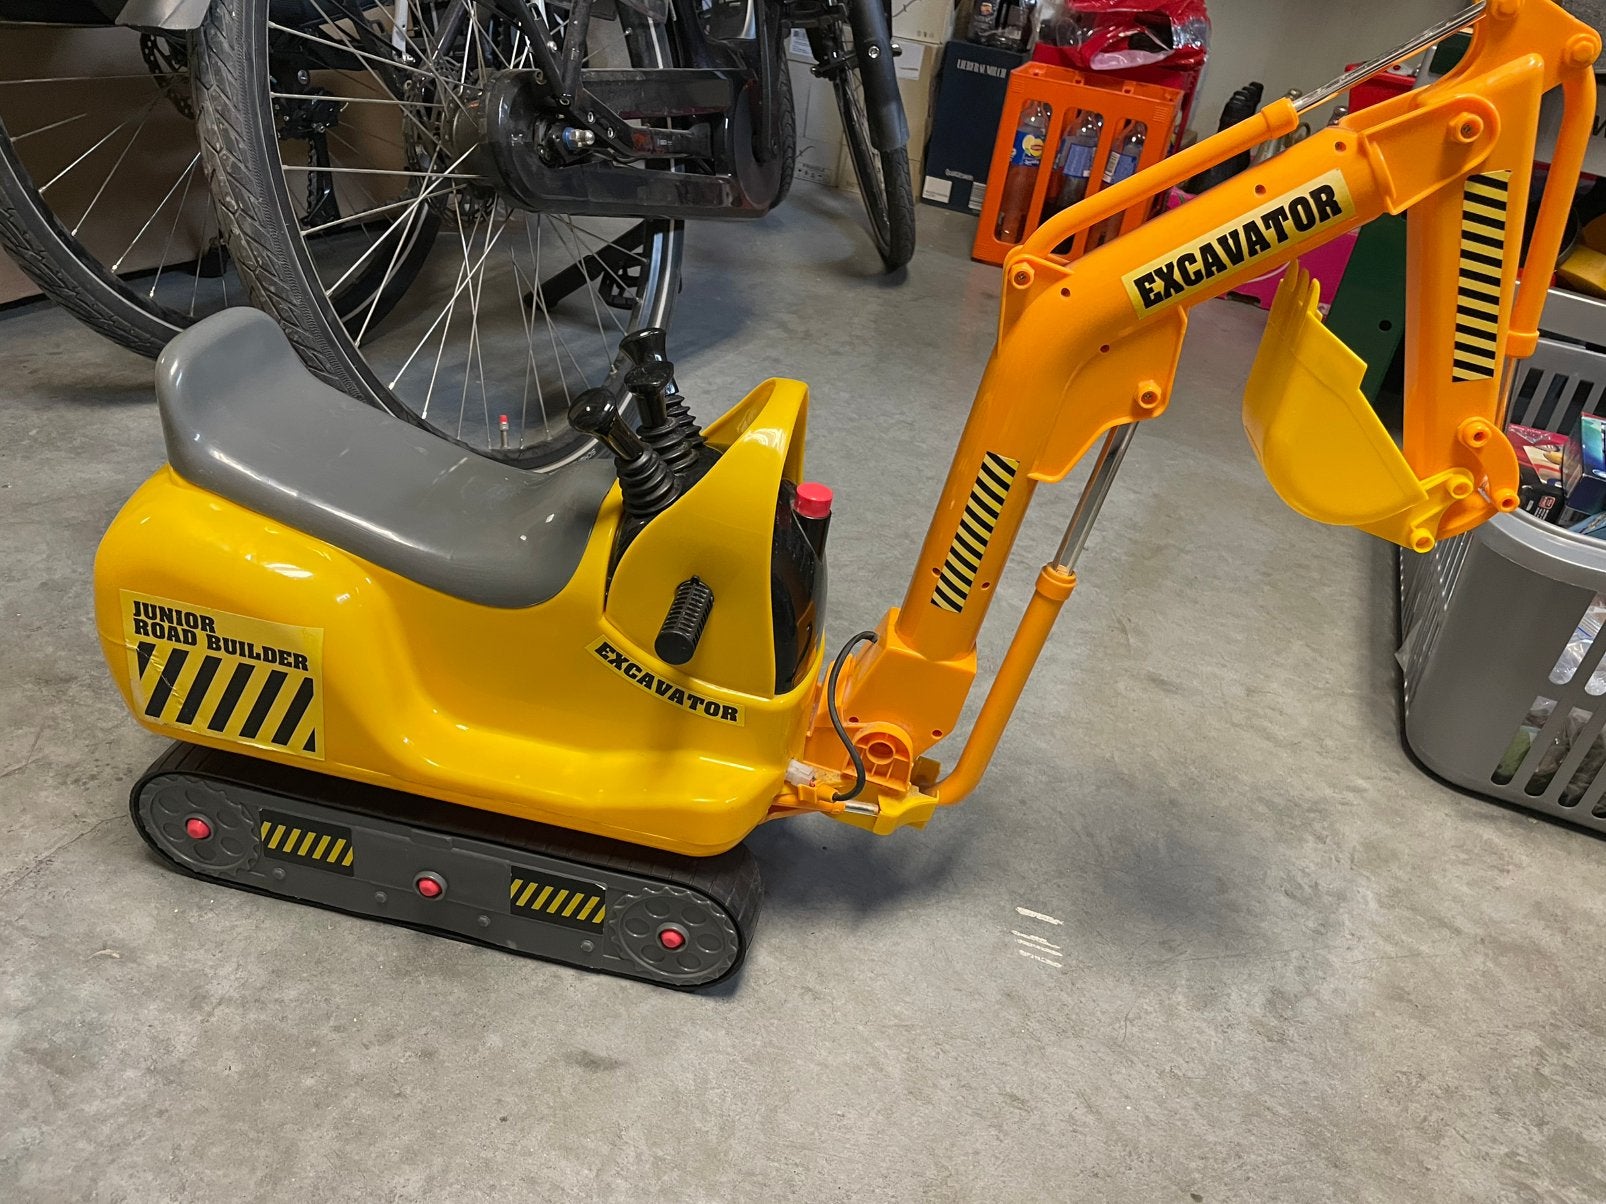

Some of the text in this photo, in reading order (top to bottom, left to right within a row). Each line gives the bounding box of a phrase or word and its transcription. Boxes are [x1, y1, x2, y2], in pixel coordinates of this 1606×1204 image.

[1133, 184, 1343, 310] EXCAVATOR
[133, 600, 216, 634] JUNIOR
[133, 618, 309, 672] ROAD BUILDER
[594, 641, 739, 723] EXCAVATOR
